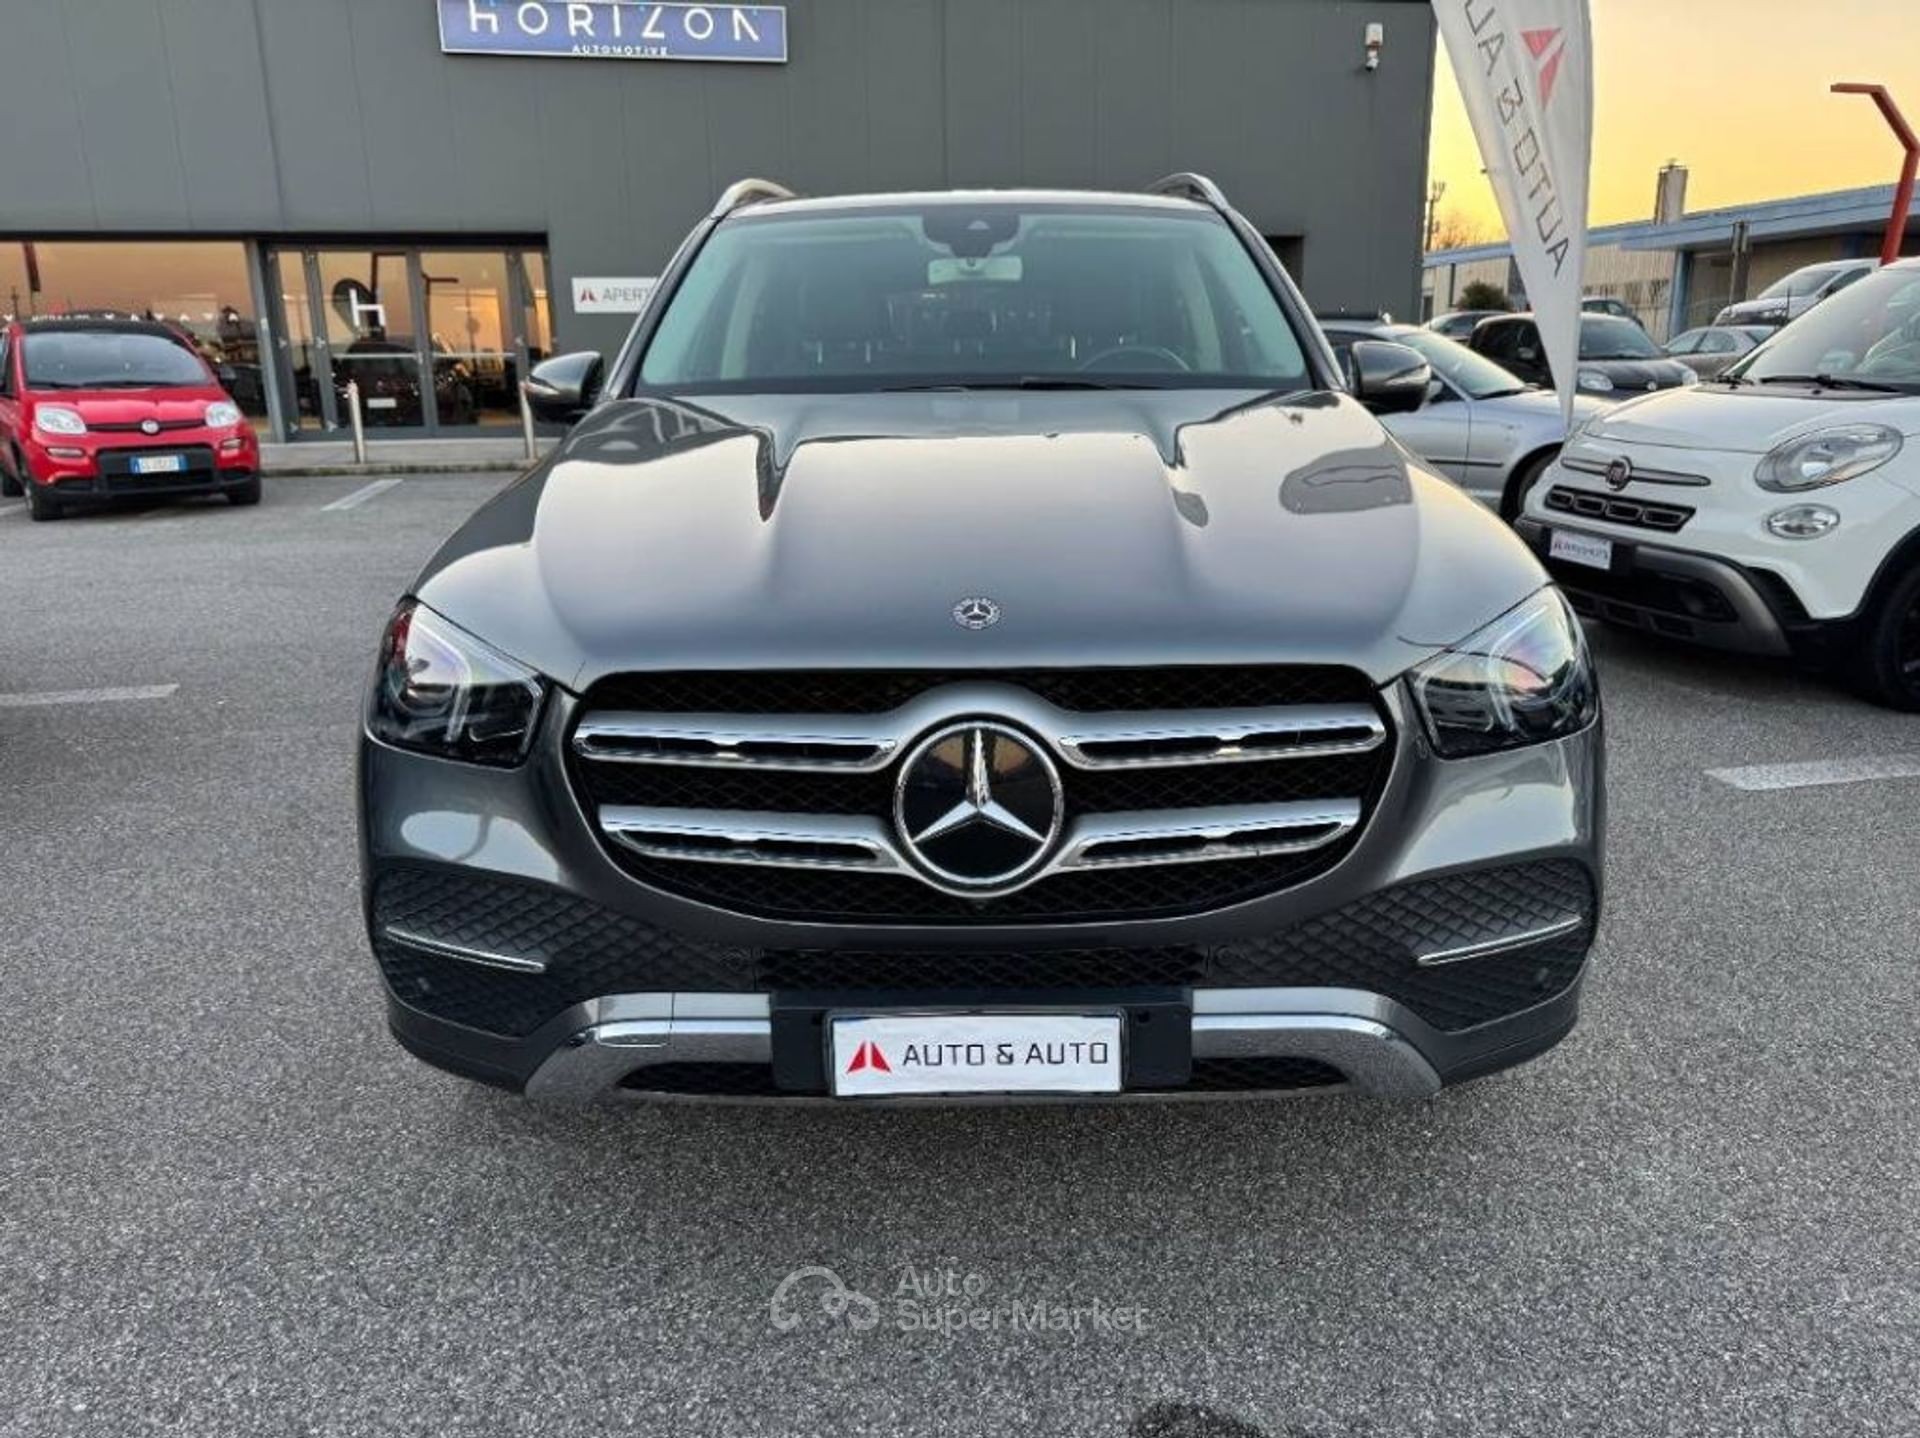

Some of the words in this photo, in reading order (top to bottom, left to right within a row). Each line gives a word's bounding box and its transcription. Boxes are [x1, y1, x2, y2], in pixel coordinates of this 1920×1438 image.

[469, 0, 761, 41] HORIZON
[571, 45, 668, 56] AUTOMOTIVE
[903, 1043, 984, 1066] AUTO
[996, 1044, 1014, 1065] &
[1025, 1042, 1108, 1065] AUTO
